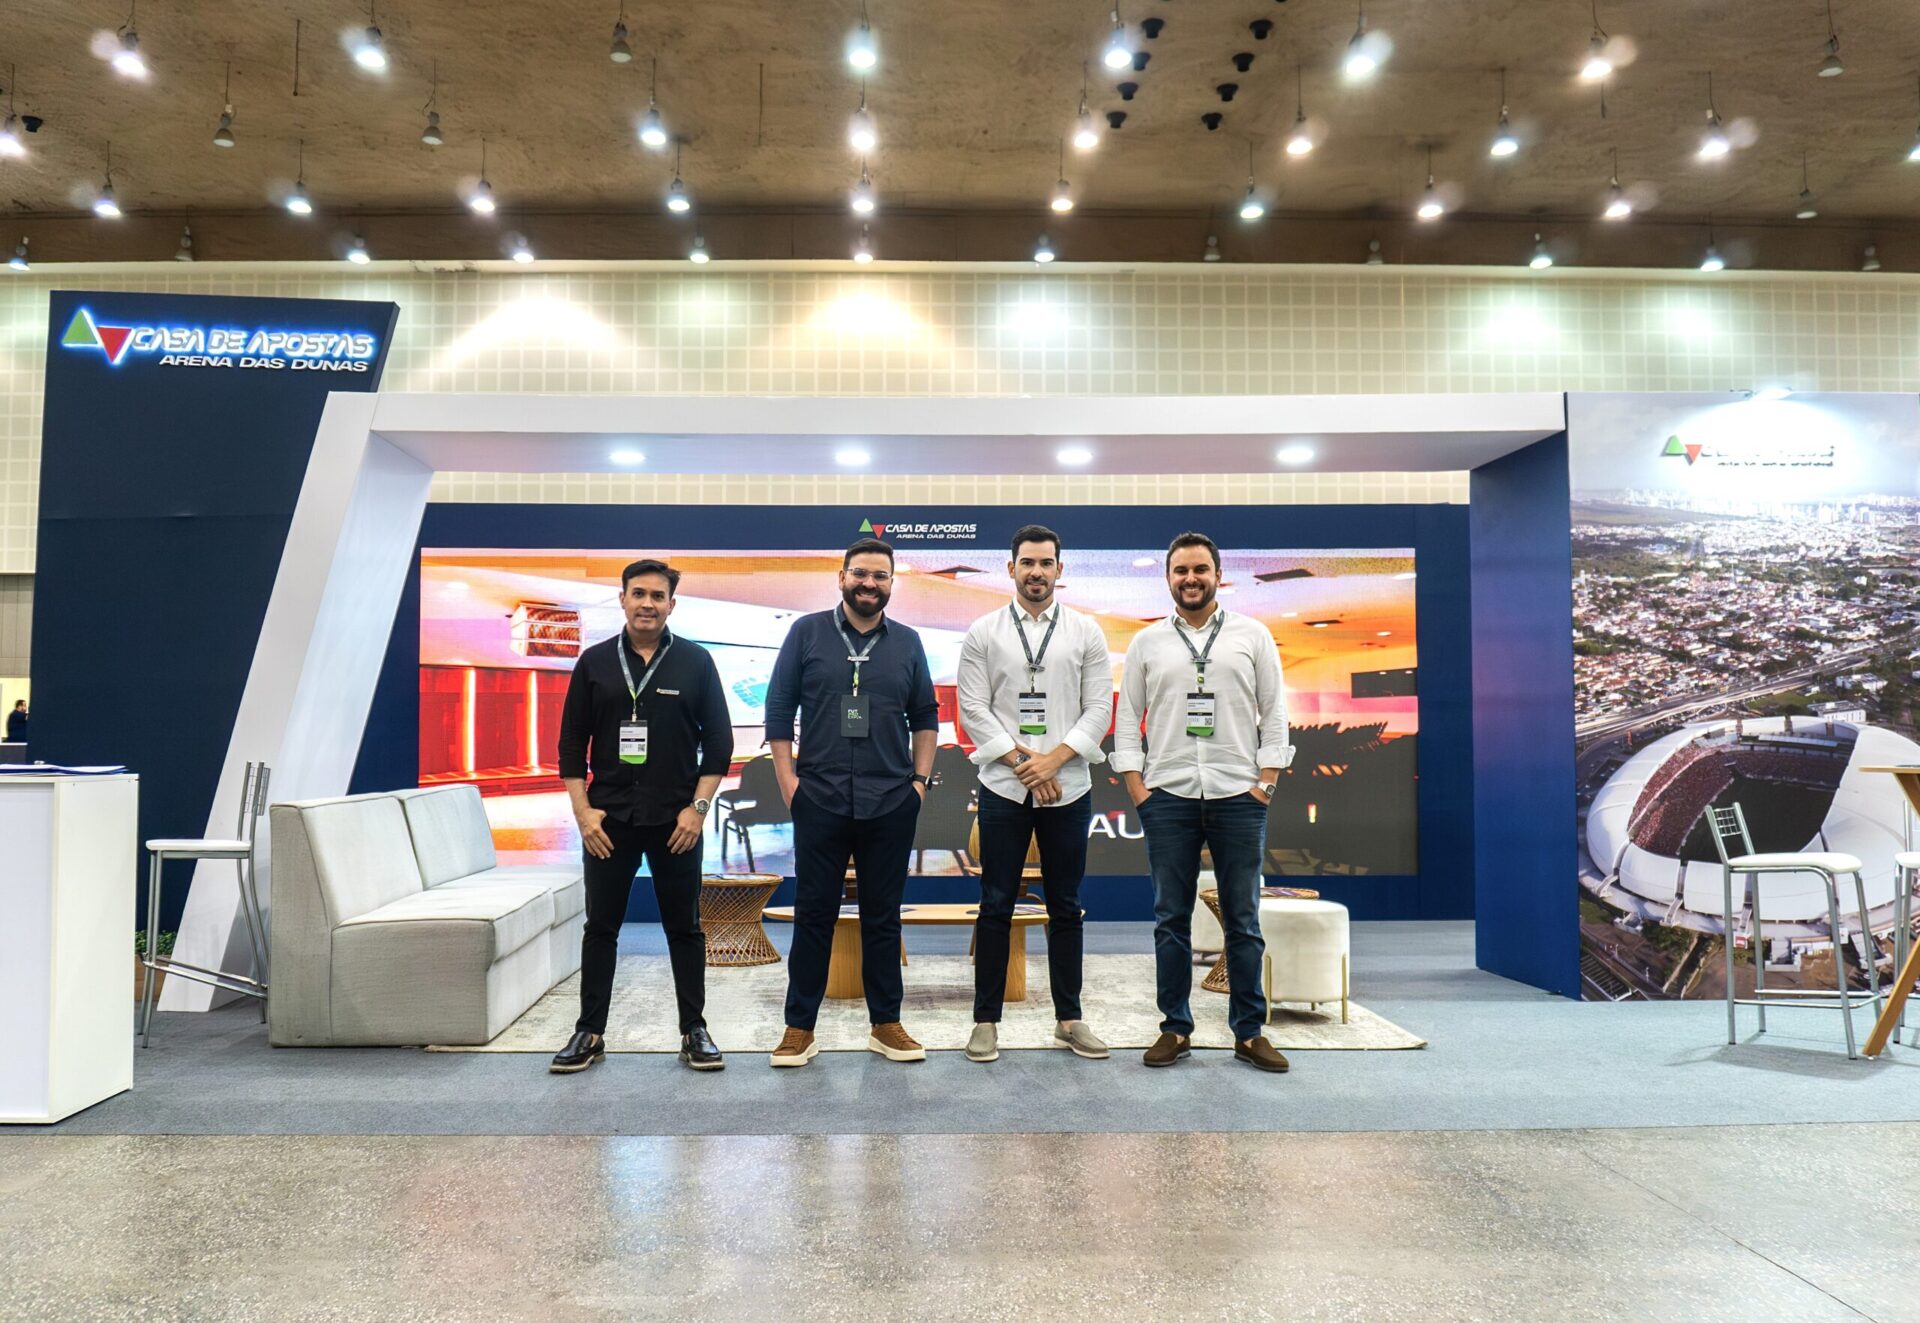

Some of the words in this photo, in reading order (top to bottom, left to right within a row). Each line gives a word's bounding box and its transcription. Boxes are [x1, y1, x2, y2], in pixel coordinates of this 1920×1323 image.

[132, 327, 204, 352] CASA
[207, 329, 248, 353] DE
[245, 331, 374, 358] APOSTAS
[159, 355, 233, 368] ARENA
[239, 357, 285, 369] DAS
[291, 359, 369, 372] DUNAS
[885, 524, 913, 532] CASA
[915, 524, 929, 532] DE
[929, 524, 977, 532] APOSTAS
